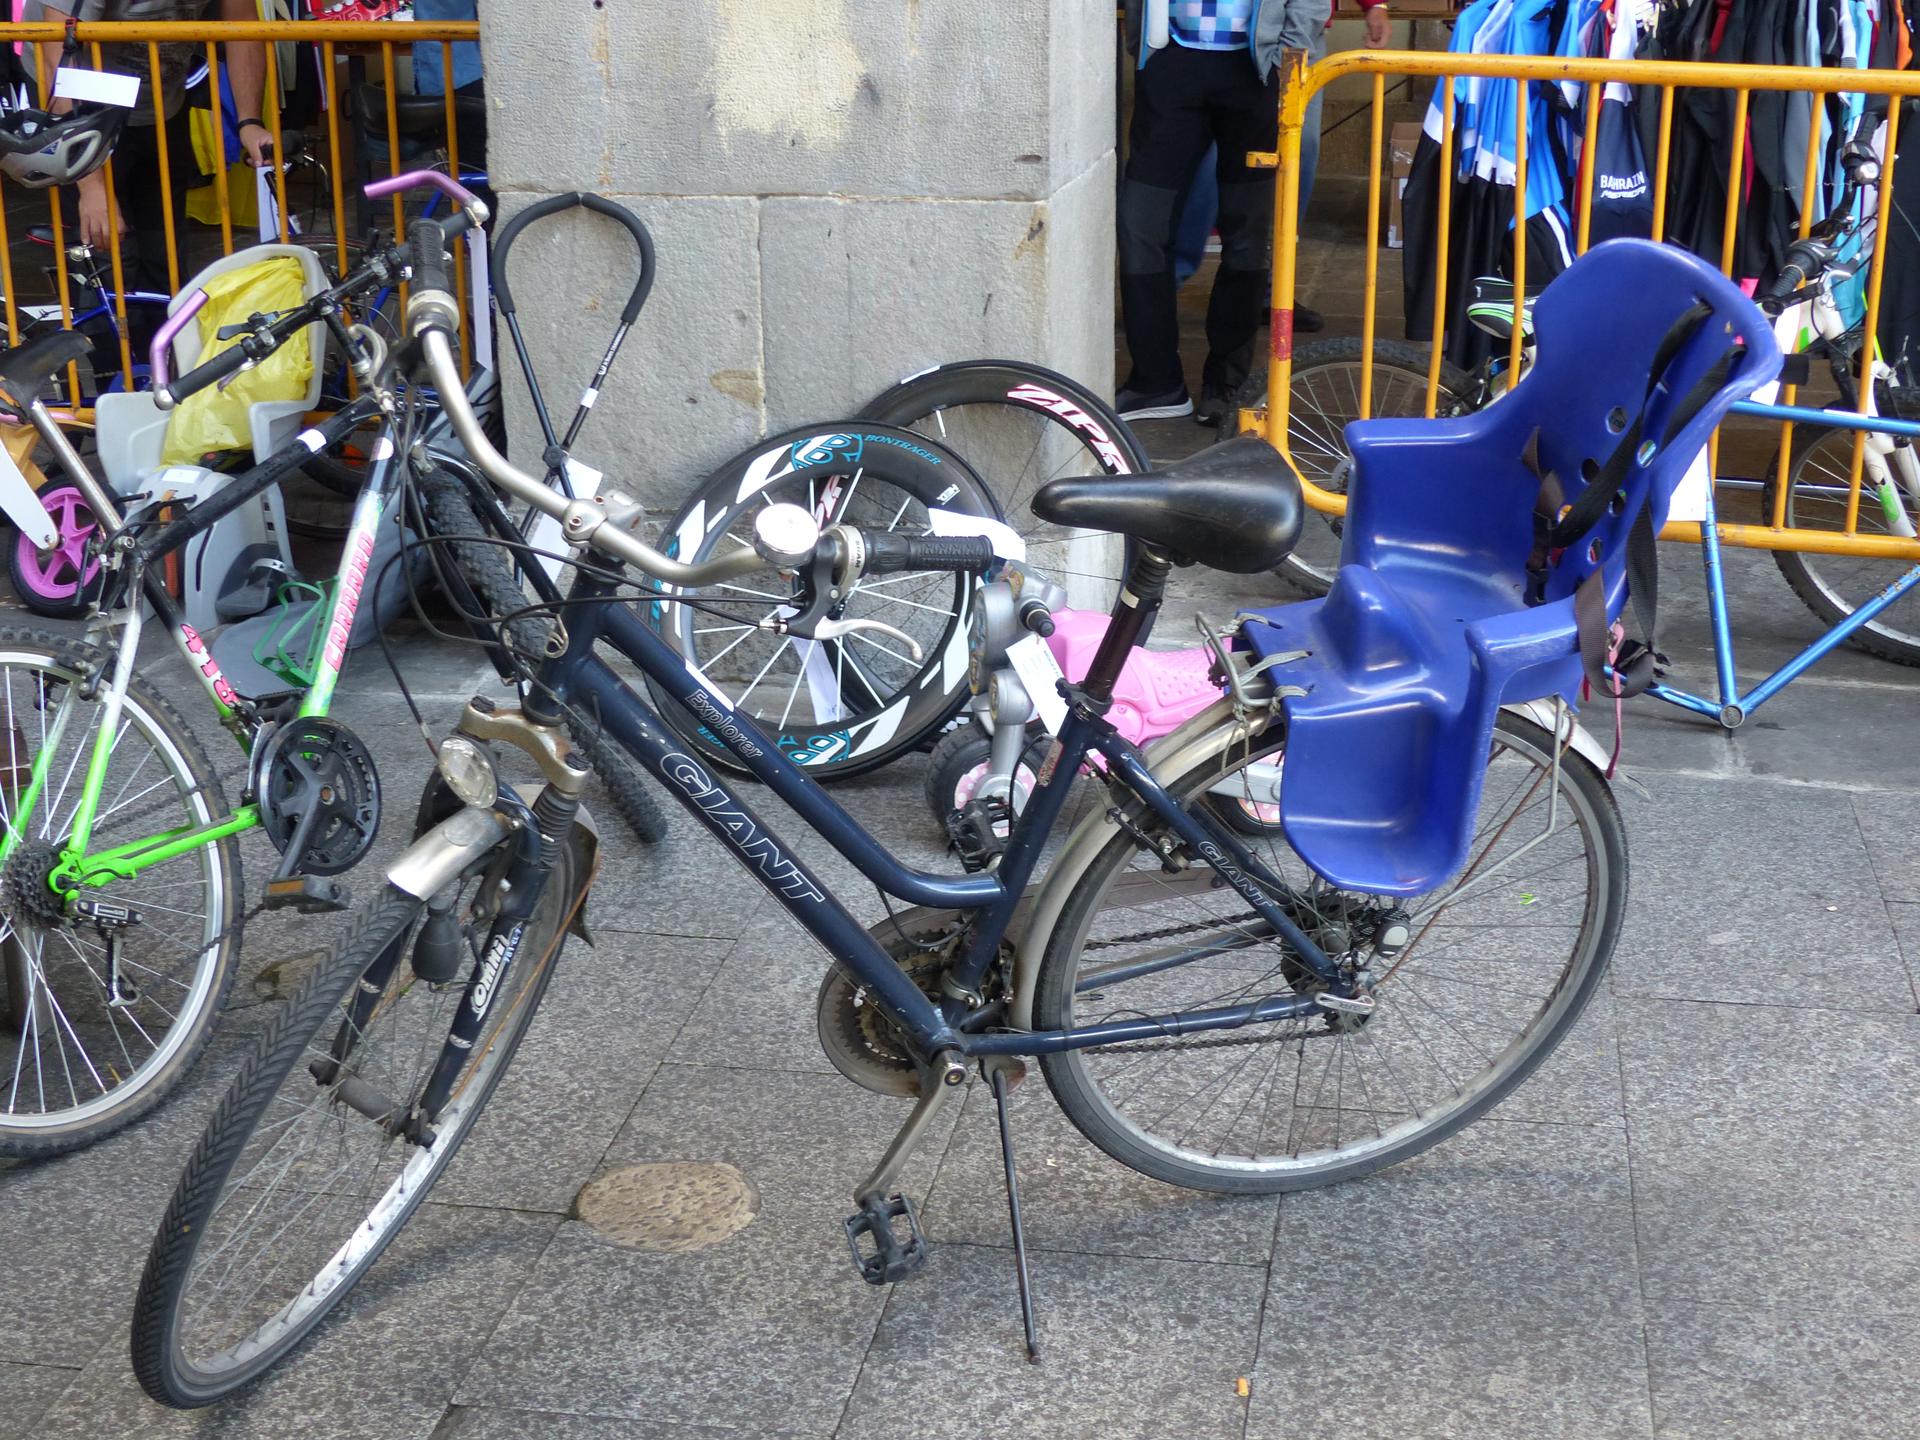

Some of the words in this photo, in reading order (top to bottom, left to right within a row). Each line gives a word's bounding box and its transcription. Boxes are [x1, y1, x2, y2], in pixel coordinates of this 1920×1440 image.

[1600, 171, 1645, 190] BAHRAIN
[864, 434, 943, 465] BONTRAGER
[1007, 383, 1132, 475] ZIPP
[685, 689, 764, 758] Explorer
[660, 752, 825, 903] GIANT
[1198, 841, 1273, 907] GIANT
